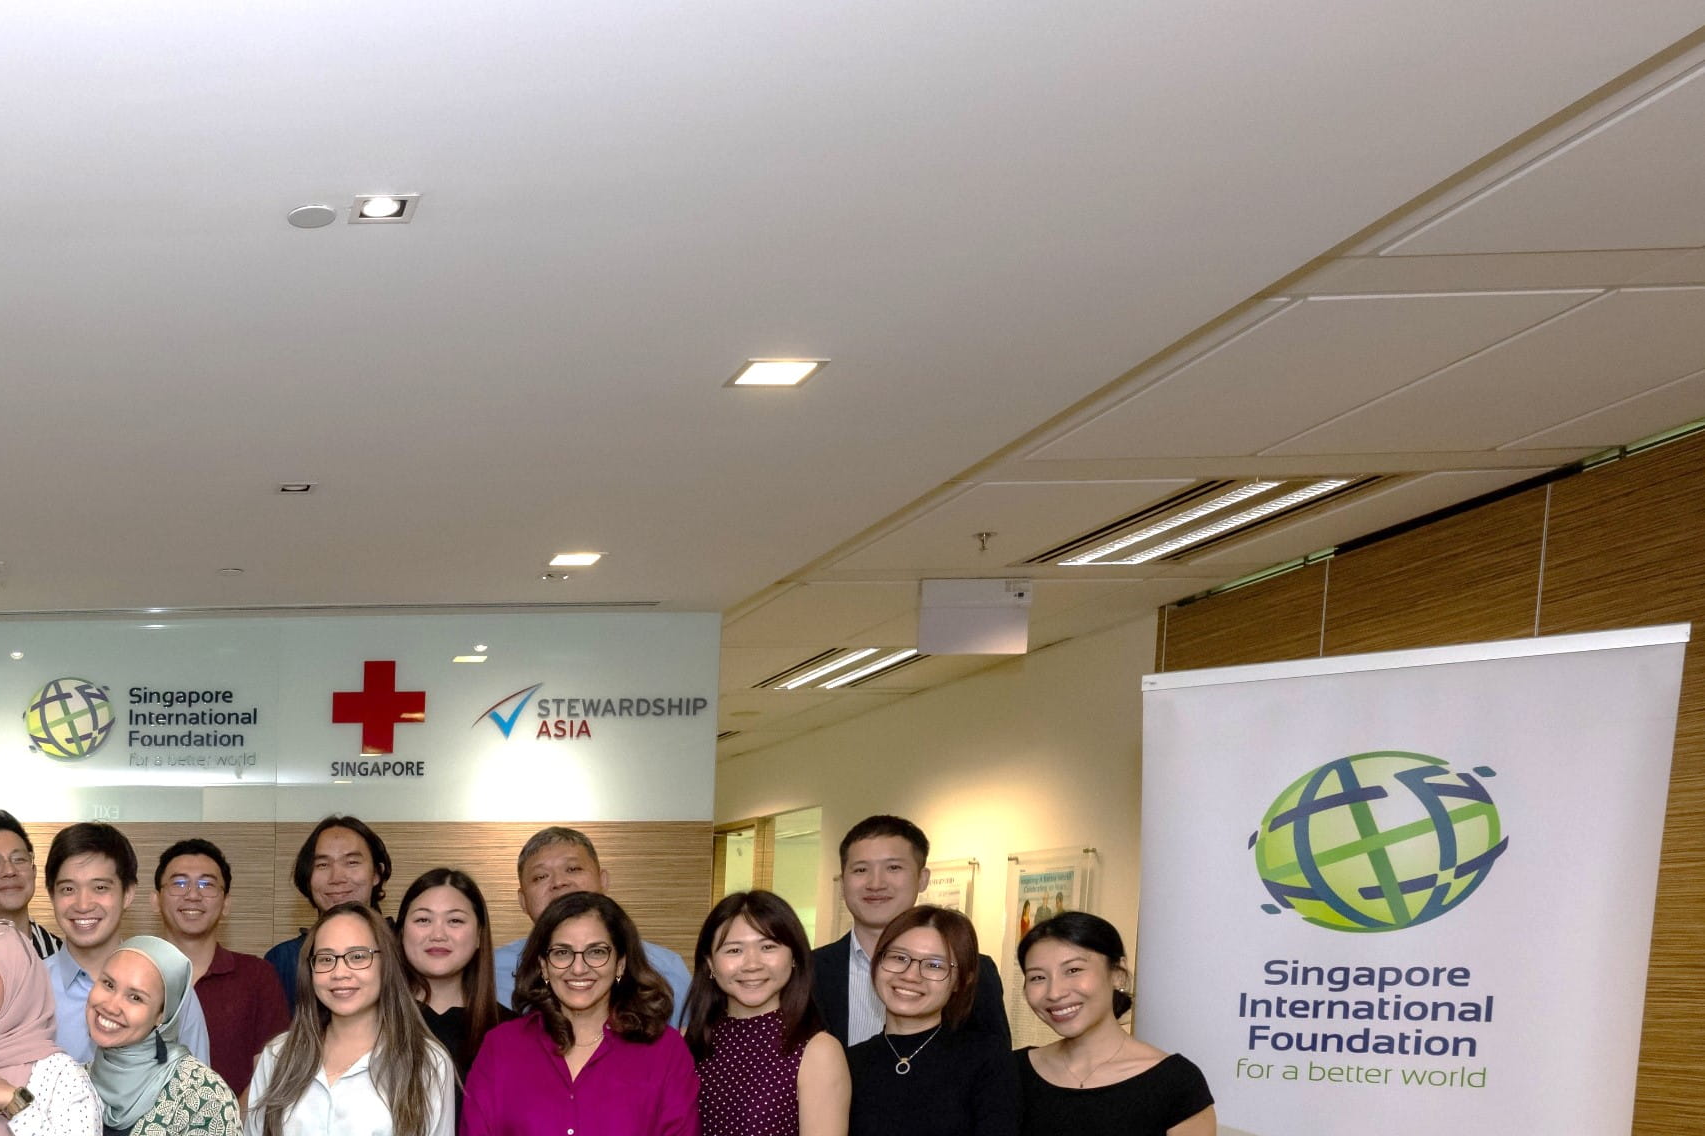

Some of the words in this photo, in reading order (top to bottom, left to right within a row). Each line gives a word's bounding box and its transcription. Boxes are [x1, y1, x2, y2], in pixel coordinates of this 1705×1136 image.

[128, 686, 234, 708] Singapore
[536, 697, 708, 718] STEWARDSHIP
[128, 707, 258, 726] International
[128, 730, 245, 747] Foundation
[536, 719, 592, 739] ASIA
[216, 752, 257, 767] world
[330, 761, 425, 777] SINGAPORE
[1263, 959, 1471, 992] Singapore
[1238, 992, 1494, 1023] International
[1248, 1025, 1477, 1057] Foundation
[1236, 1057, 1274, 1080] for
[1282, 1064, 1298, 1080] a
[1308, 1061, 1392, 1085] better
[1401, 1066, 1487, 1088] world
